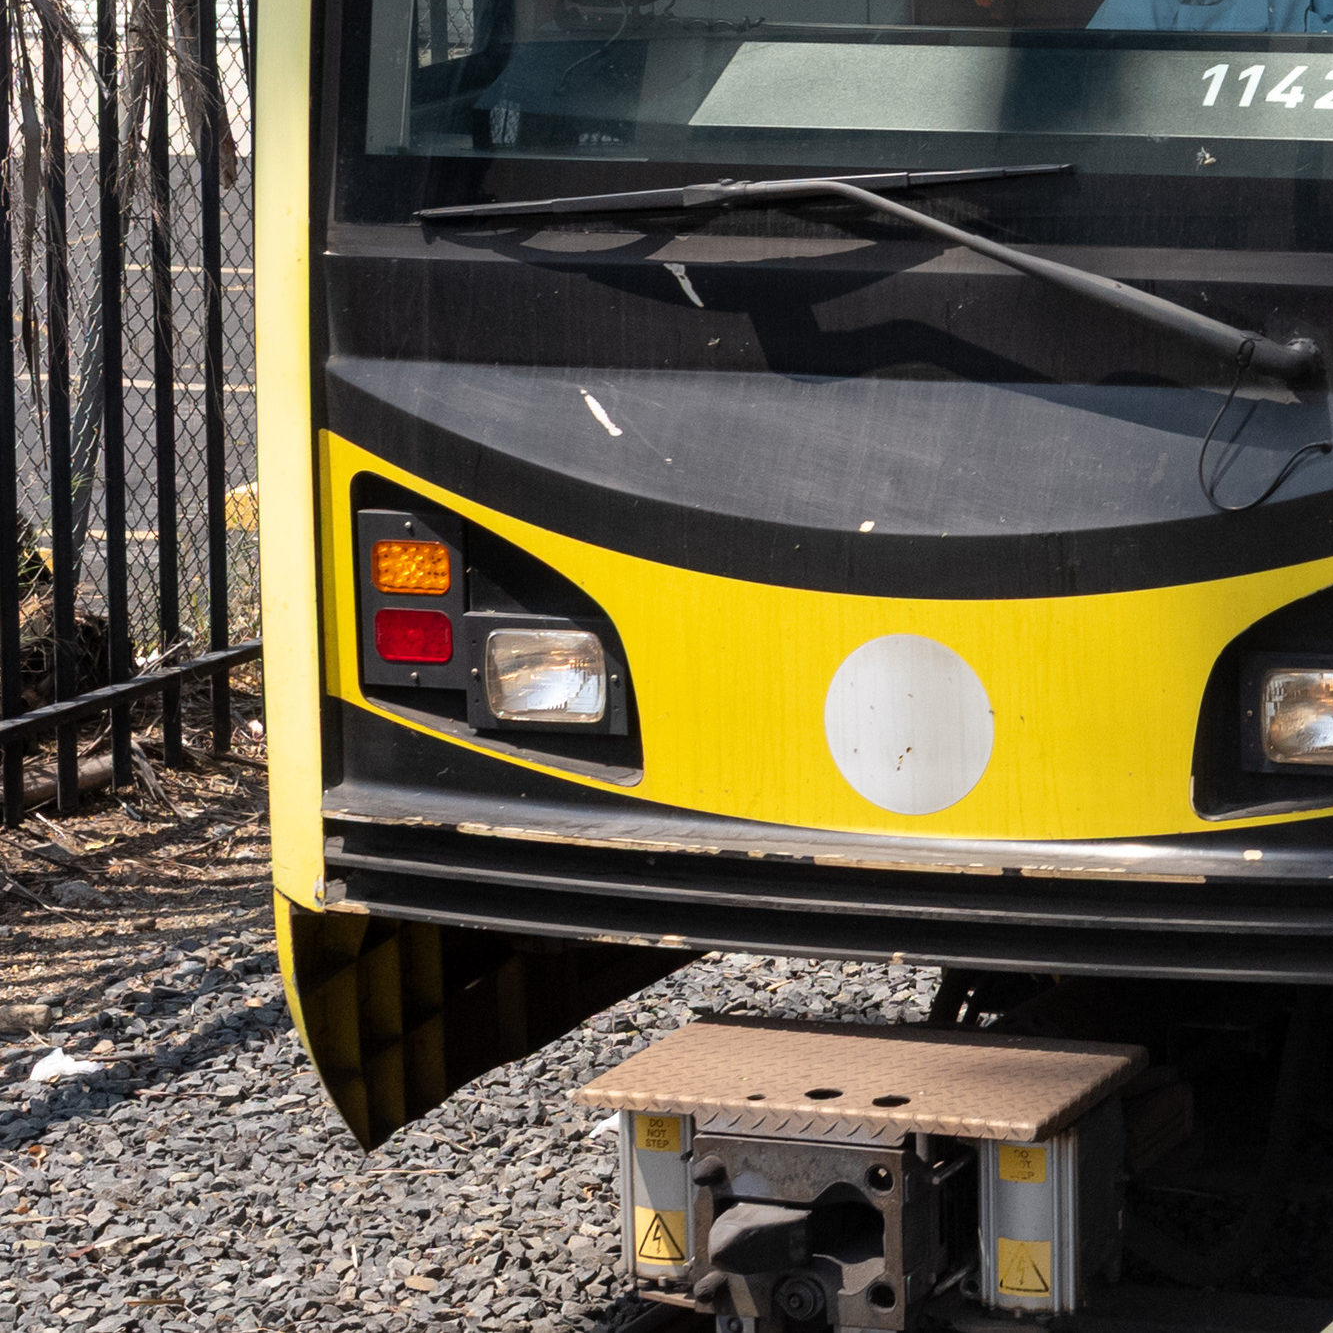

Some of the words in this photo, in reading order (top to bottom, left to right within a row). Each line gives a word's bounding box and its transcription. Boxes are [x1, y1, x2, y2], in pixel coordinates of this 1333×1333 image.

[648, 1118, 664, 1128] DO
[647, 1128, 667, 1138] NOT
[645, 1138, 670, 1149] STEP
